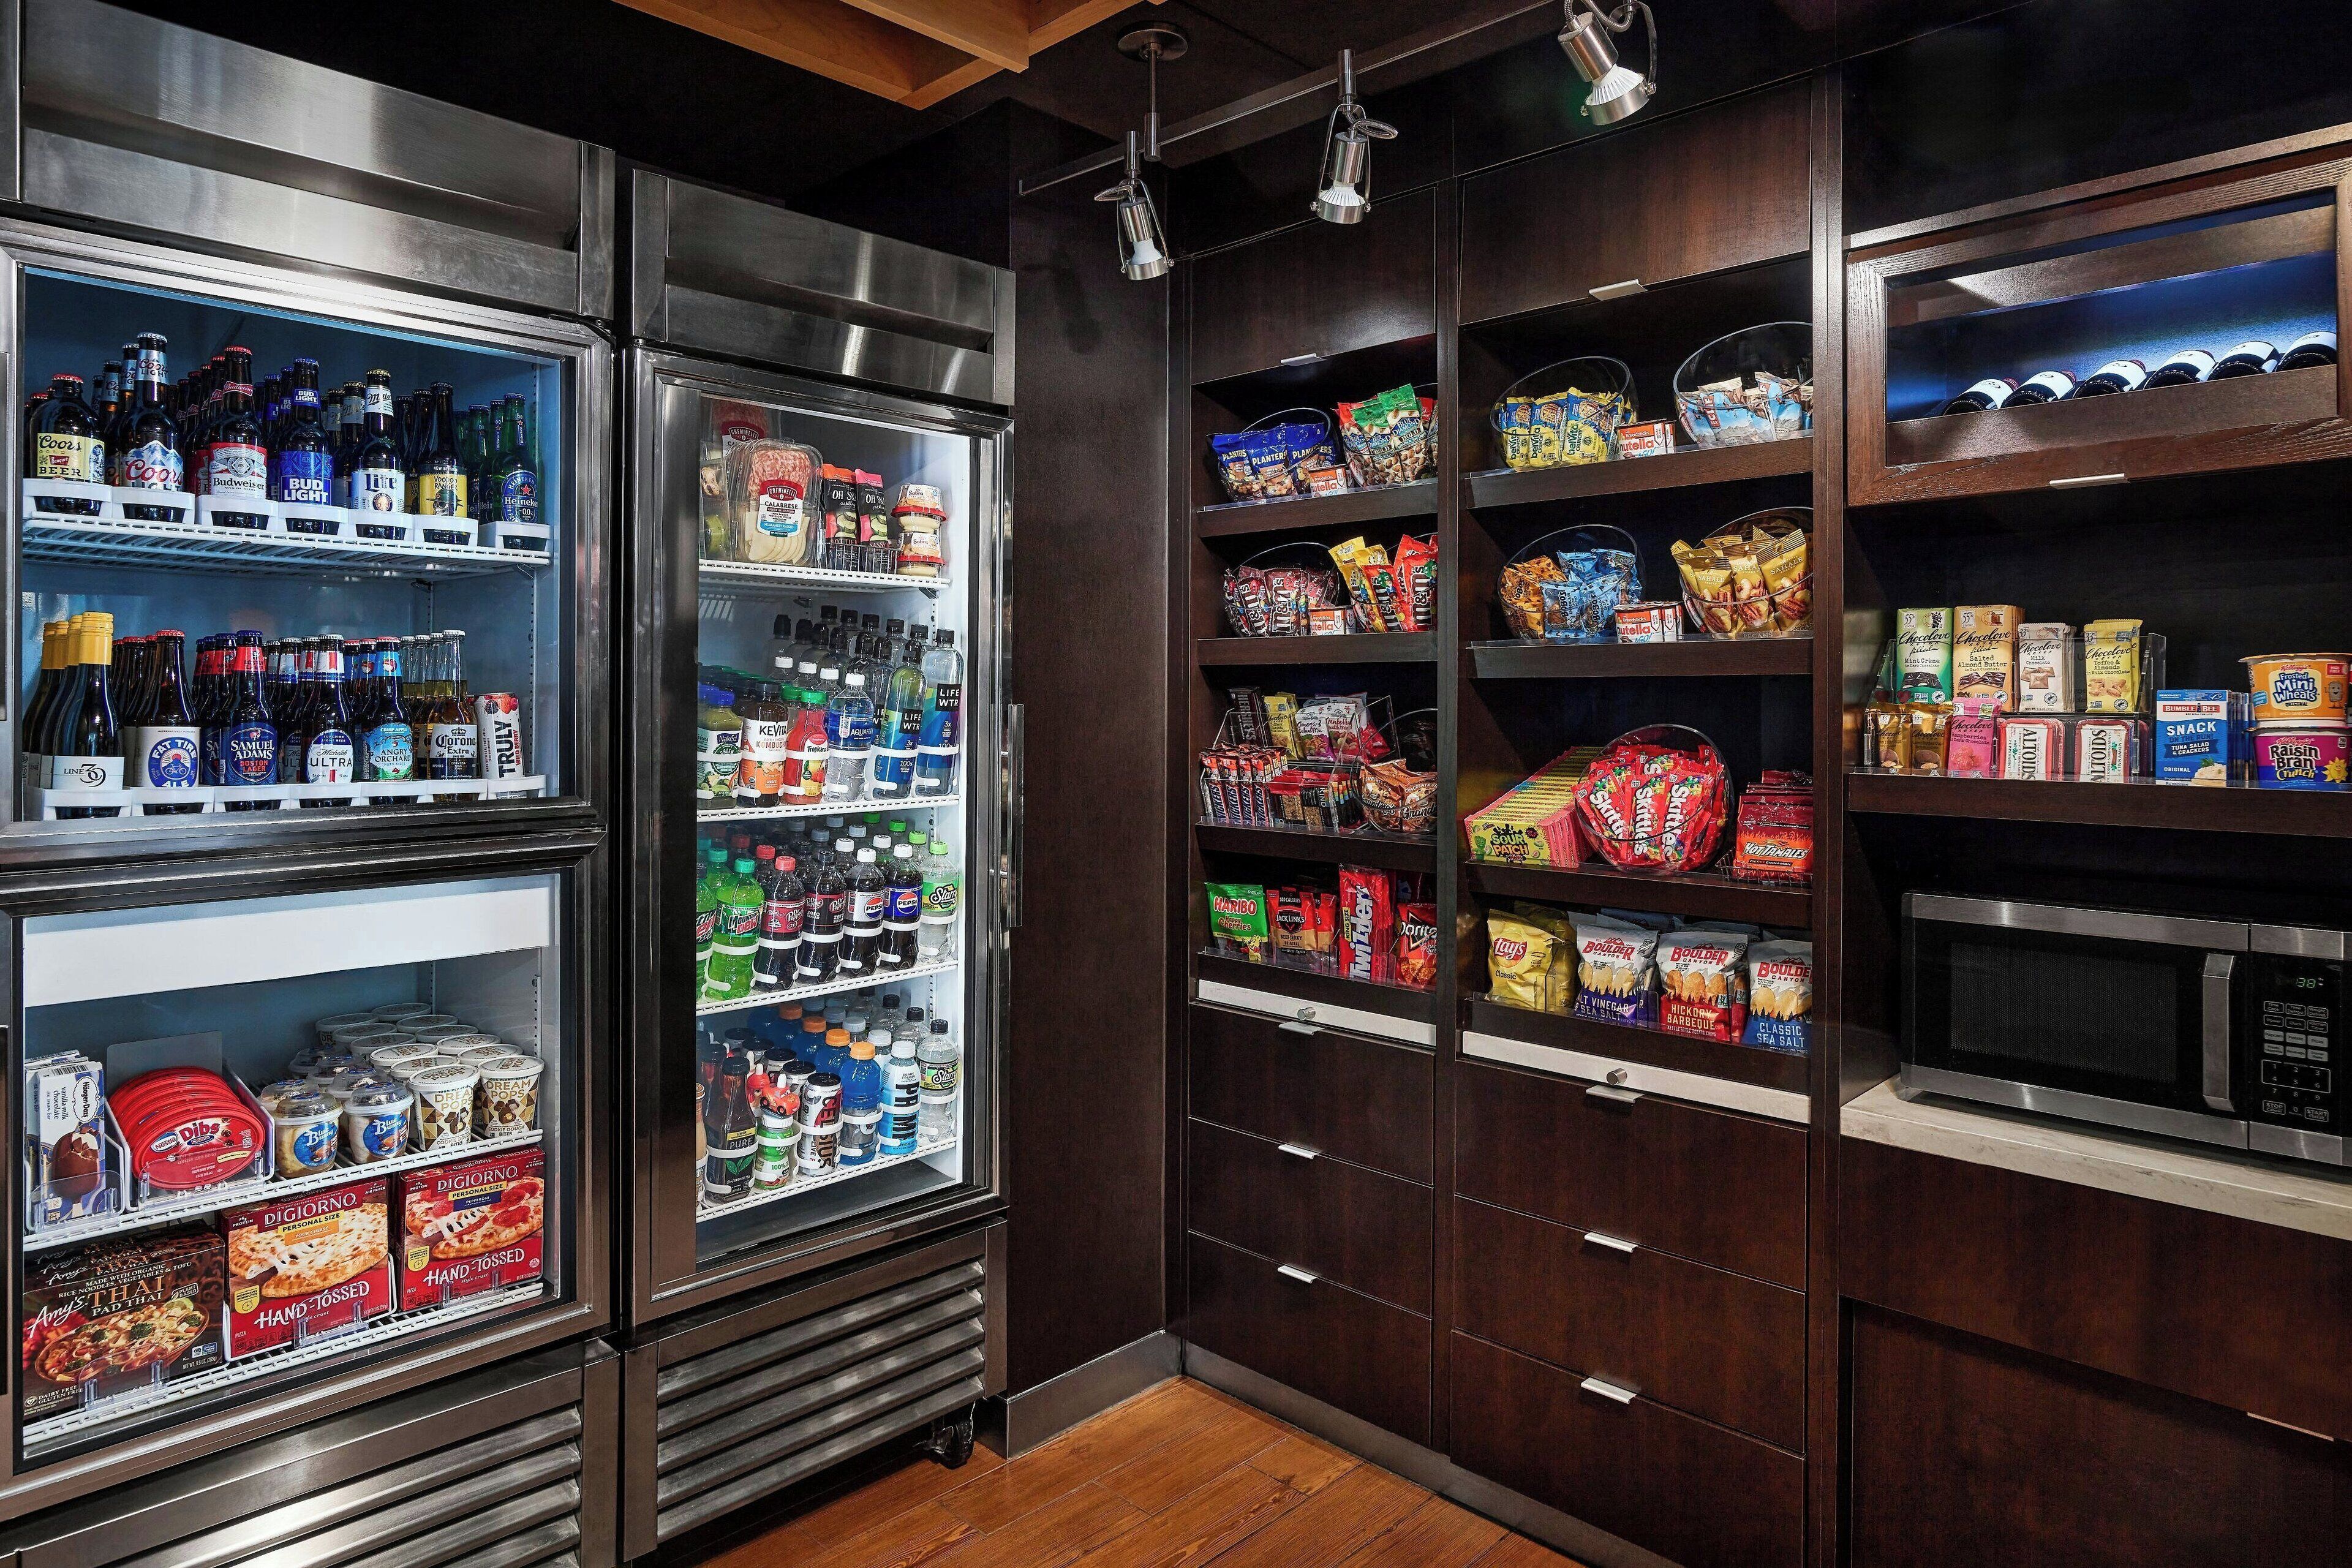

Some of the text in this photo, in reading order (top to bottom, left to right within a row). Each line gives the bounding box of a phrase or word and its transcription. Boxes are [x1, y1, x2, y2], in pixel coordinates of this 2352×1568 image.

[225, 382, 253, 393] Budweiser
[40, 435, 81, 451] Coors
[1531, 428, 1540, 458] belVita
[1567, 424, 1579, 455] belVita
[1222, 450, 1247, 461] PLANTERS
[1252, 452, 1287, 465] PLANTERS
[39, 467, 81, 477] BEER
[126, 459, 182, 485] Coors
[213, 477, 265, 490] Budweiser
[289, 478, 323, 490] BUD
[364, 473, 397, 491] Lite
[284, 490, 328, 502] LIGHT
[769, 487, 796, 497] CREMINELLI
[832, 491, 844, 499] OH
[1770, 556, 1804, 575] SAHALE
[1697, 575, 1725, 584] SAHALE
[1898, 629, 1950, 644] Chocolove
[1955, 628, 2011, 644] Chocolove
[1909, 645, 1939, 657] filled
[2019, 641, 2062, 654] Chocolove
[2086, 646, 2131, 659] Chocolove
[940, 688, 959, 697] LIFE
[2275, 679, 2315, 692] Mini
[2274, 688, 2317, 703] Wheats
[760, 725, 787, 737] KEVITA
[2166, 721, 2217, 736] SNACK
[435, 734, 477, 749] Corona
[718, 734, 737, 742] Naked
[152, 739, 197, 759] FAT TIRE
[230, 741, 274, 752] SAMUEL
[496, 720, 516, 778] TRULY
[2269, 745, 2320, 760] Raisin
[234, 749, 273, 761] ADAMS
[310, 757, 352, 767] ULTRA
[2275, 756, 2315, 770] Bran
[80, 764, 106, 787] 39
[2277, 768, 2315, 780] Crunch
[1491, 834, 1524, 845] SOUR
[1493, 844, 1529, 856] PATCH
[1742, 842, 1809, 859] HOT TAMALES
[1213, 896, 1257, 916] HARIBO
[1218, 918, 1251, 931] Cherries
[1401, 921, 1437, 937] Dorito
[1582, 941, 1635, 960] BOULDER
[1670, 947, 1728, 965] BOULDER
[1495, 970, 1517, 980] Classic
[1592, 998, 1629, 1012] VINEGAR
[1671, 1004, 1713, 1019] HICKORY
[1581, 1005, 1621, 1020] SEA SALT
[1667, 1014, 1716, 1030] BARBEQUE
[1759, 1023, 1803, 1036] CLASSIC
[1757, 1033, 1804, 1048] SEA SALT
[486, 1079, 530, 1090] DREAM
[491, 1090, 524, 1099] POPS
[179, 1121, 220, 1142] Dibs
[729, 1140, 753, 1150] PURE
[452, 1187, 488, 1199] PERSONAL
[233, 1219, 254, 1227] PROTEIN
[282, 1213, 340, 1232] PERSONAL SIZE
[78, 1281, 117, 1294] NOODLES,
[118, 1269, 164, 1286] VEGETABLES
[173, 1262, 192, 1271] TOFU
[86, 1264, 167, 1287] MADE WITH ORGANIC
[88, 1275, 165, 1308] THAI
[179, 1284, 197, 1294] PLANT
[179, 1289, 197, 1298] BASED
[92, 1292, 162, 1317] PAD THAI
[28, 1294, 89, 1339] Amy's
[38, 1385, 78, 1400] DAIRY FREE
[38, 1388, 83, 1404] GLUTEN FREE
